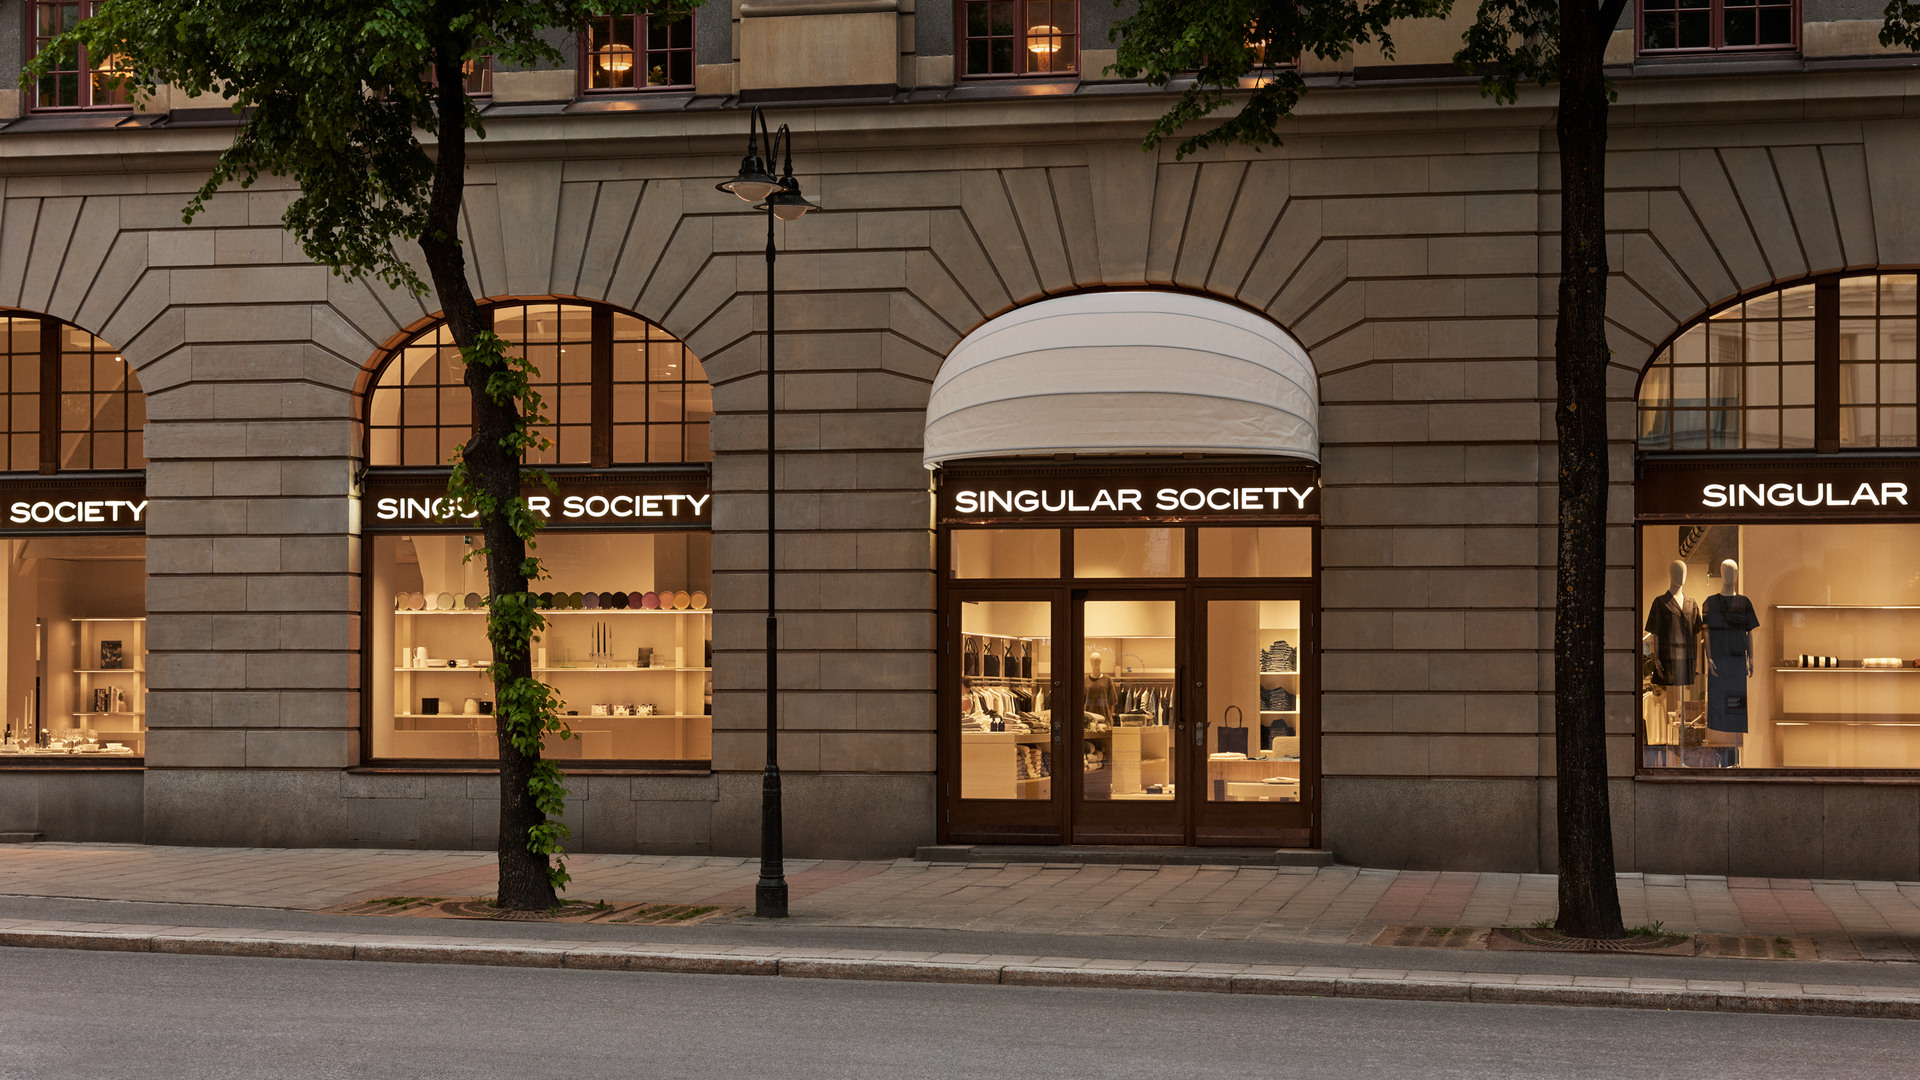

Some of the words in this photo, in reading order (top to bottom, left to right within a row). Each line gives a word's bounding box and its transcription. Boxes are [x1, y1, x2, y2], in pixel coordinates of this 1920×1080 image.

[376, 496, 552, 520] SINGUR
[562, 494, 710, 518] SOCIETY
[954, 488, 1143, 513] SINGULAR
[1155, 486, 1314, 511] SOCIETY
[1702, 482, 1909, 508] SINGULAR
[9, 500, 149, 524] SOCIETY
